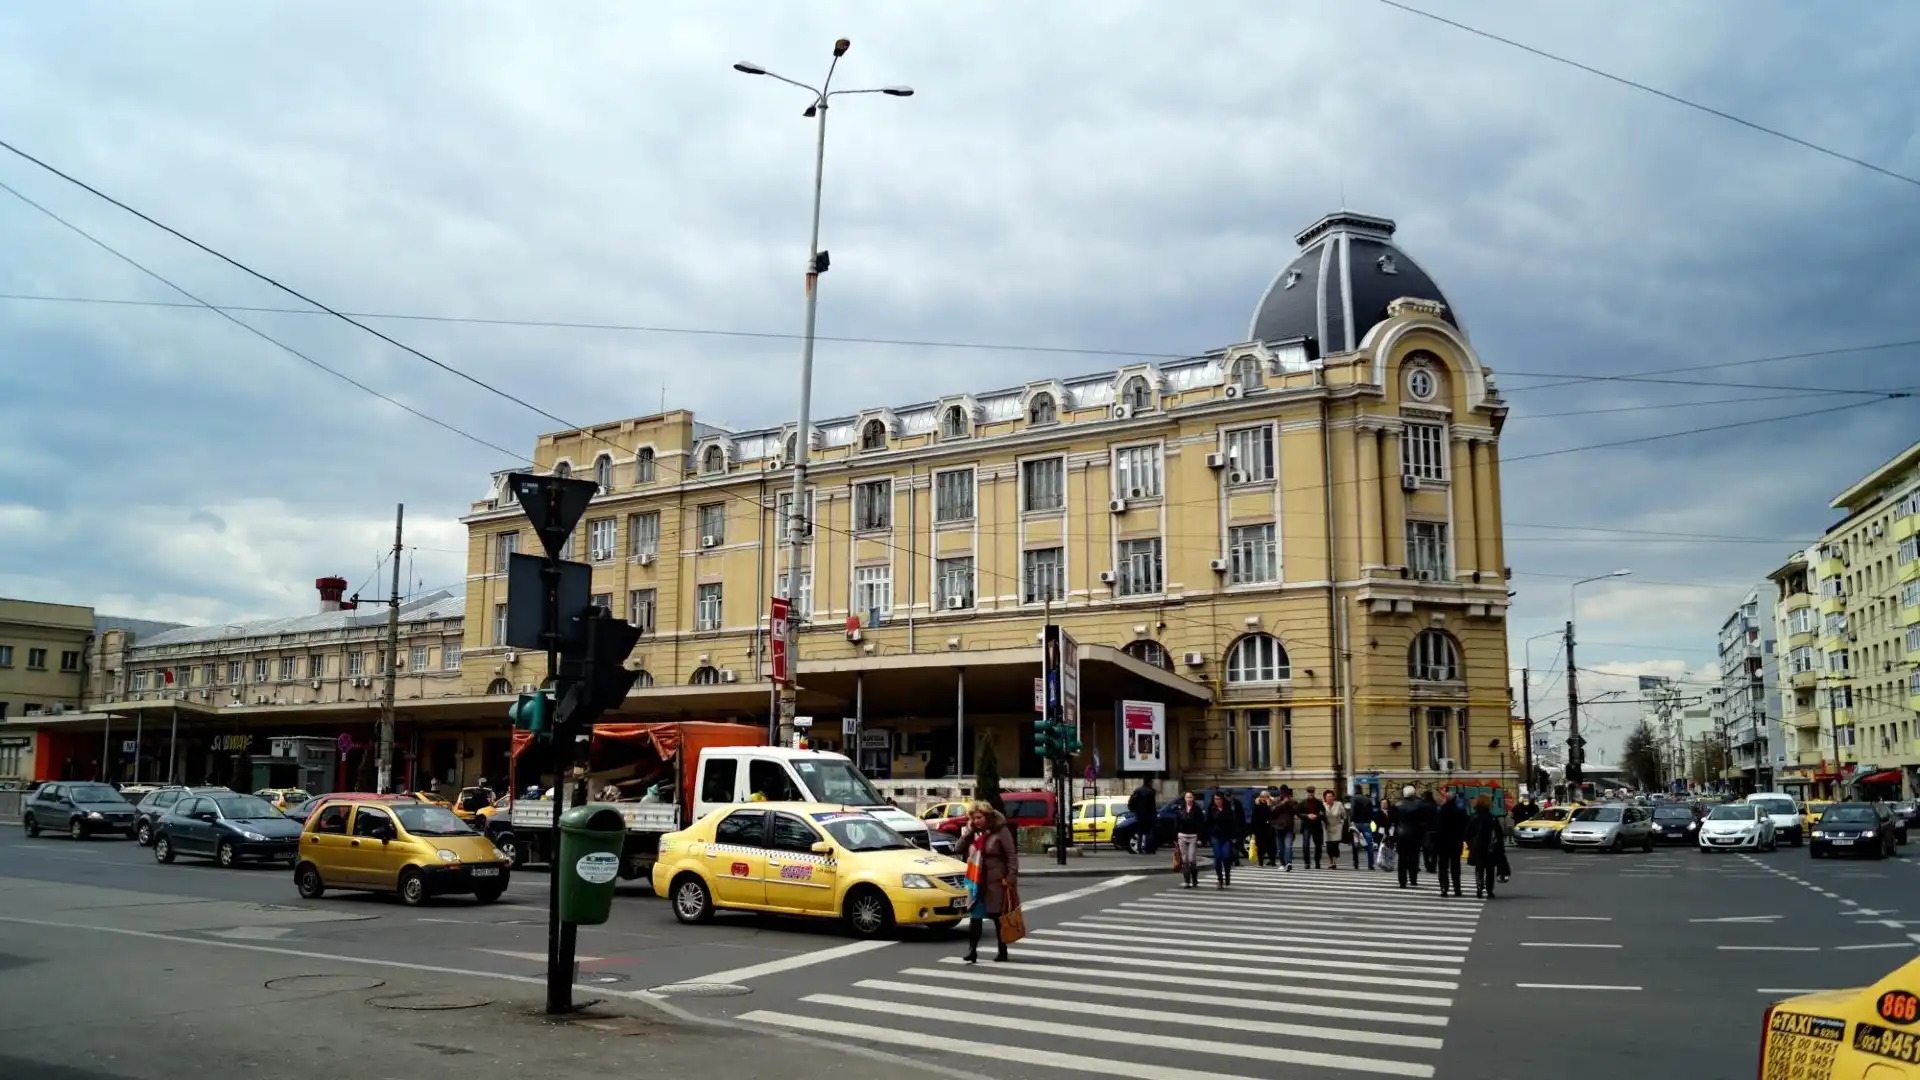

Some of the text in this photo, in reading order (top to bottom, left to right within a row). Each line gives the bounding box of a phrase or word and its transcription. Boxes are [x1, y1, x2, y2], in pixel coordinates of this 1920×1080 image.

[1883, 994, 1917, 1020] 866
[1798, 1037, 1811, 1050] 00
[1812, 1041, 1840, 1054] 9451
[1862, 1030, 1920, 1062] 021 9451
[1794, 1051, 1808, 1063] 00
[1809, 1054, 1835, 1069] 9451
